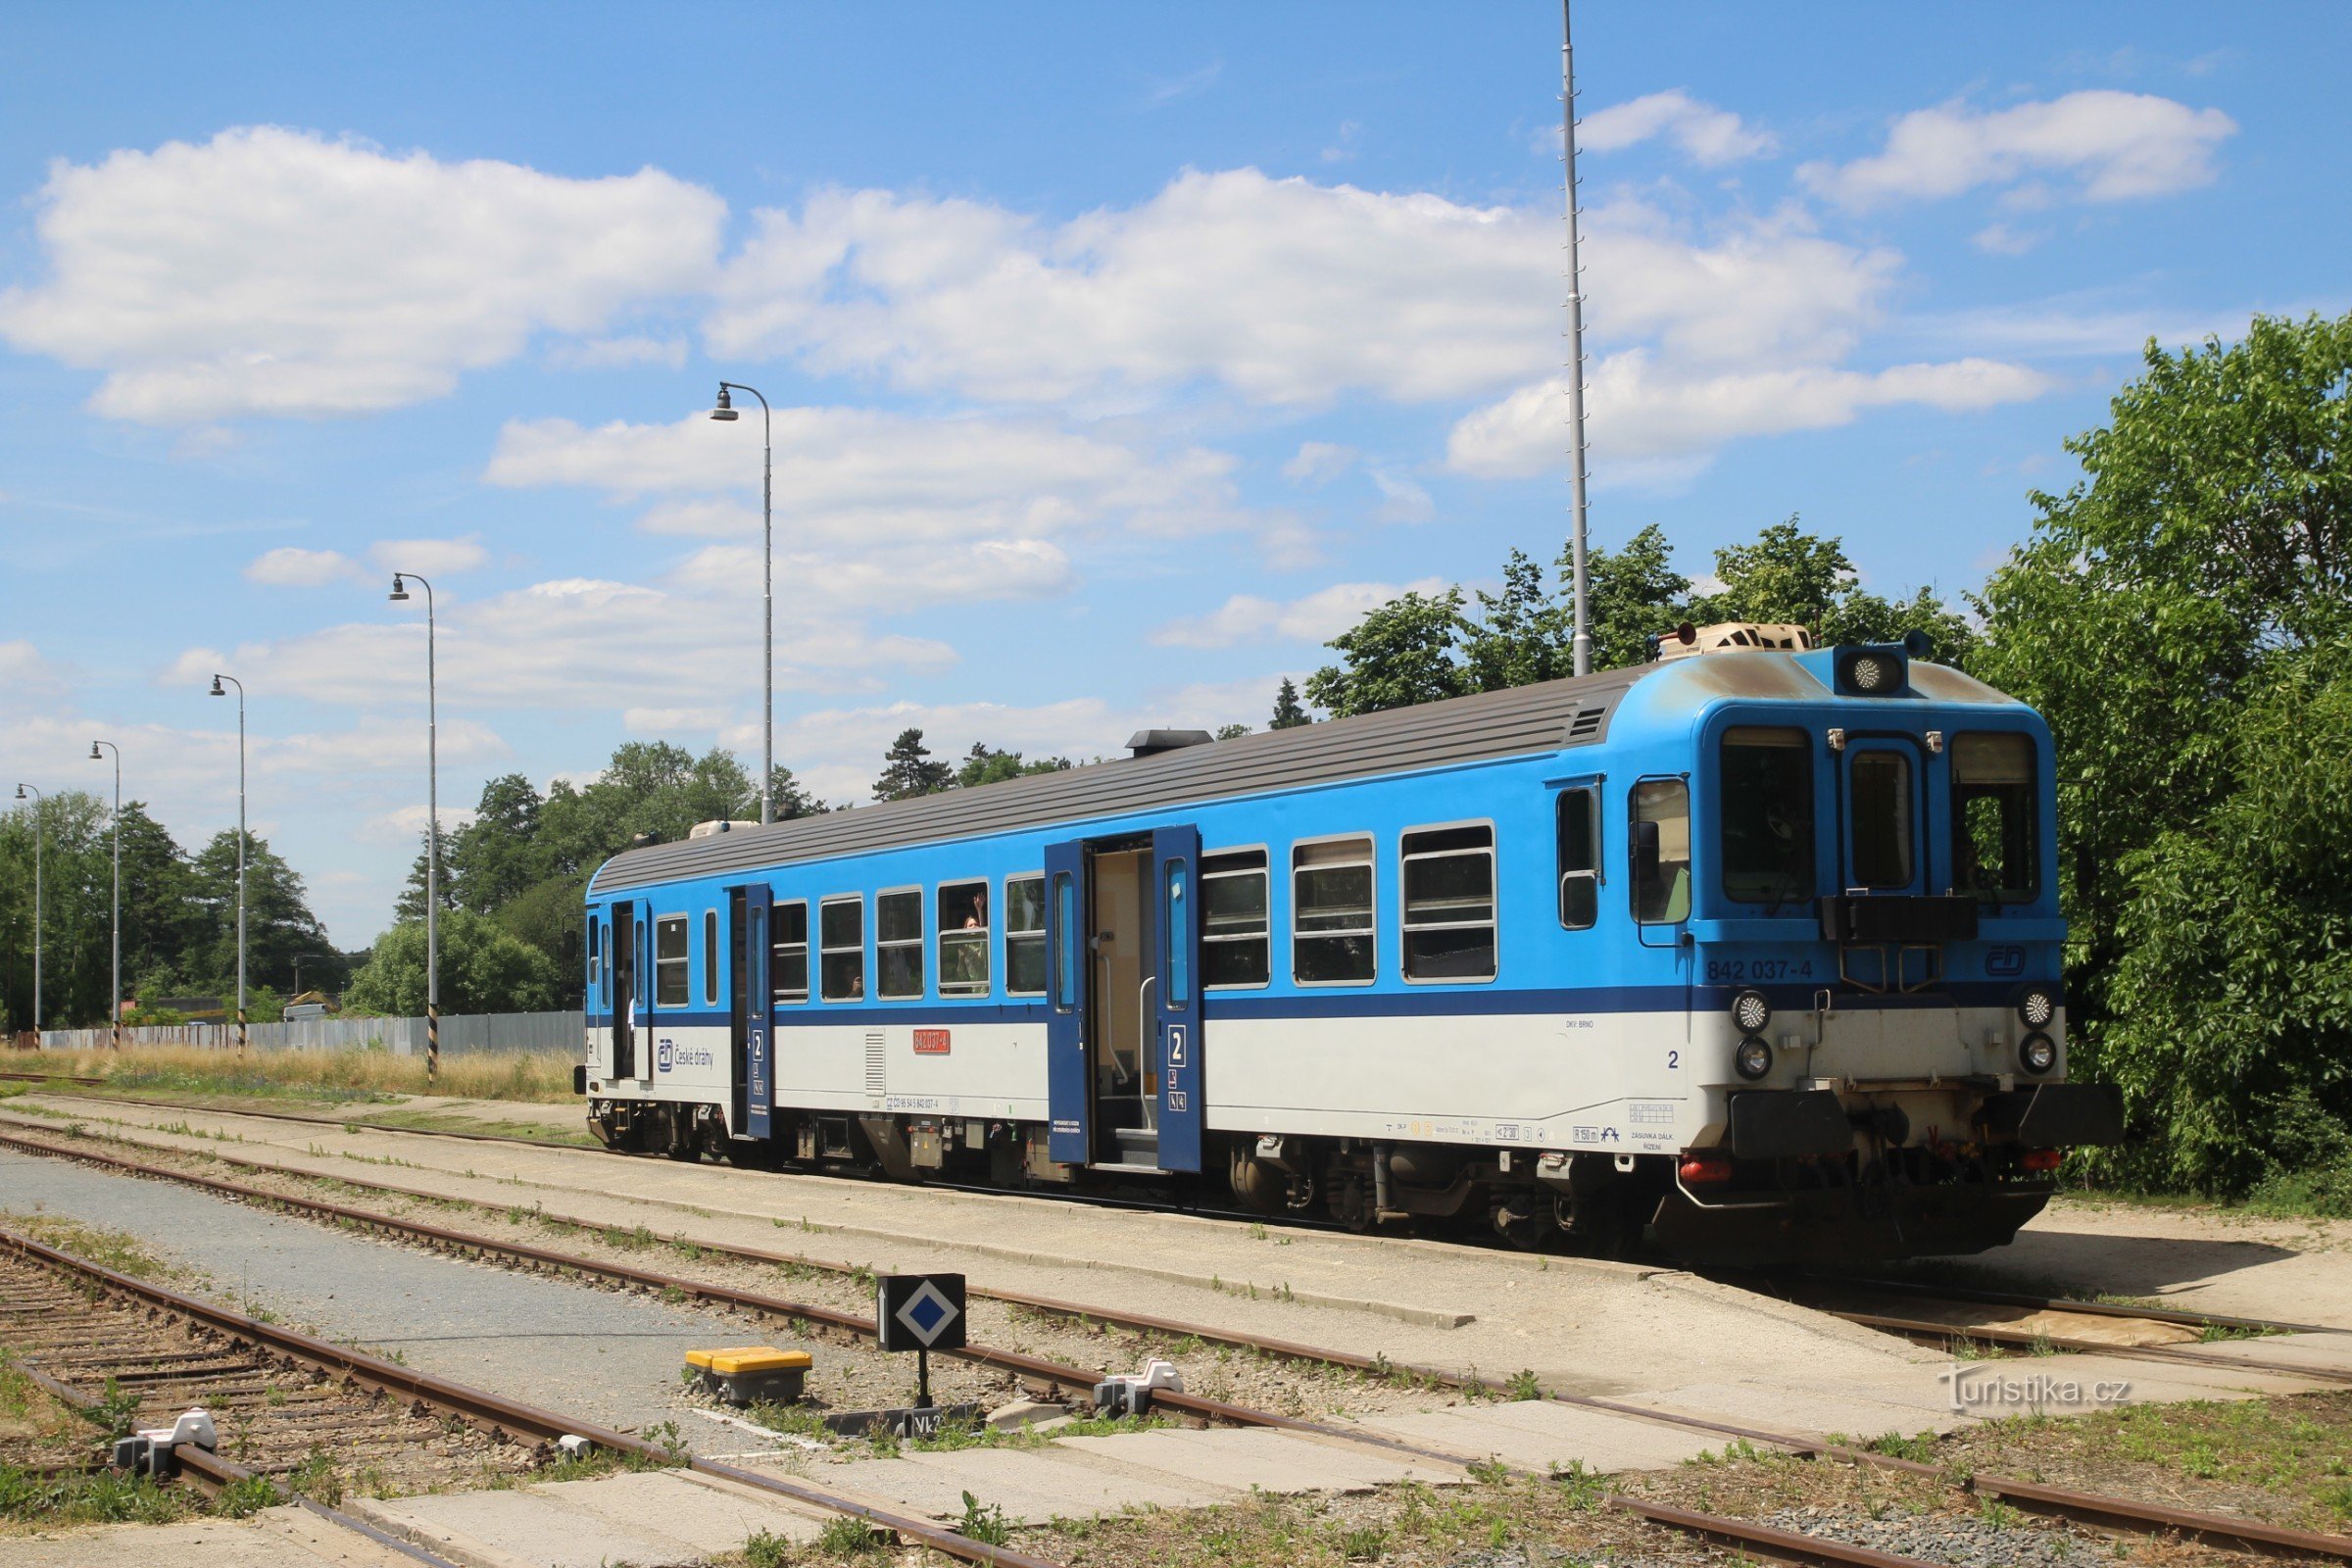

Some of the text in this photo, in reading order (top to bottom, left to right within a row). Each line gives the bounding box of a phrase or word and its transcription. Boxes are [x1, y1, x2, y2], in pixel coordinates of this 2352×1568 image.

[1707, 959, 1813, 980] 842 037-4
[1579, 1020, 1594, 1029] BRNO
[755, 1035, 761, 1056] 2
[915, 1032, 947, 1051] 842 037-4
[1172, 1031, 1182, 1059] 2
[674, 1044, 713, 1071] České dráhy
[1668, 1050, 1679, 1069] 2
